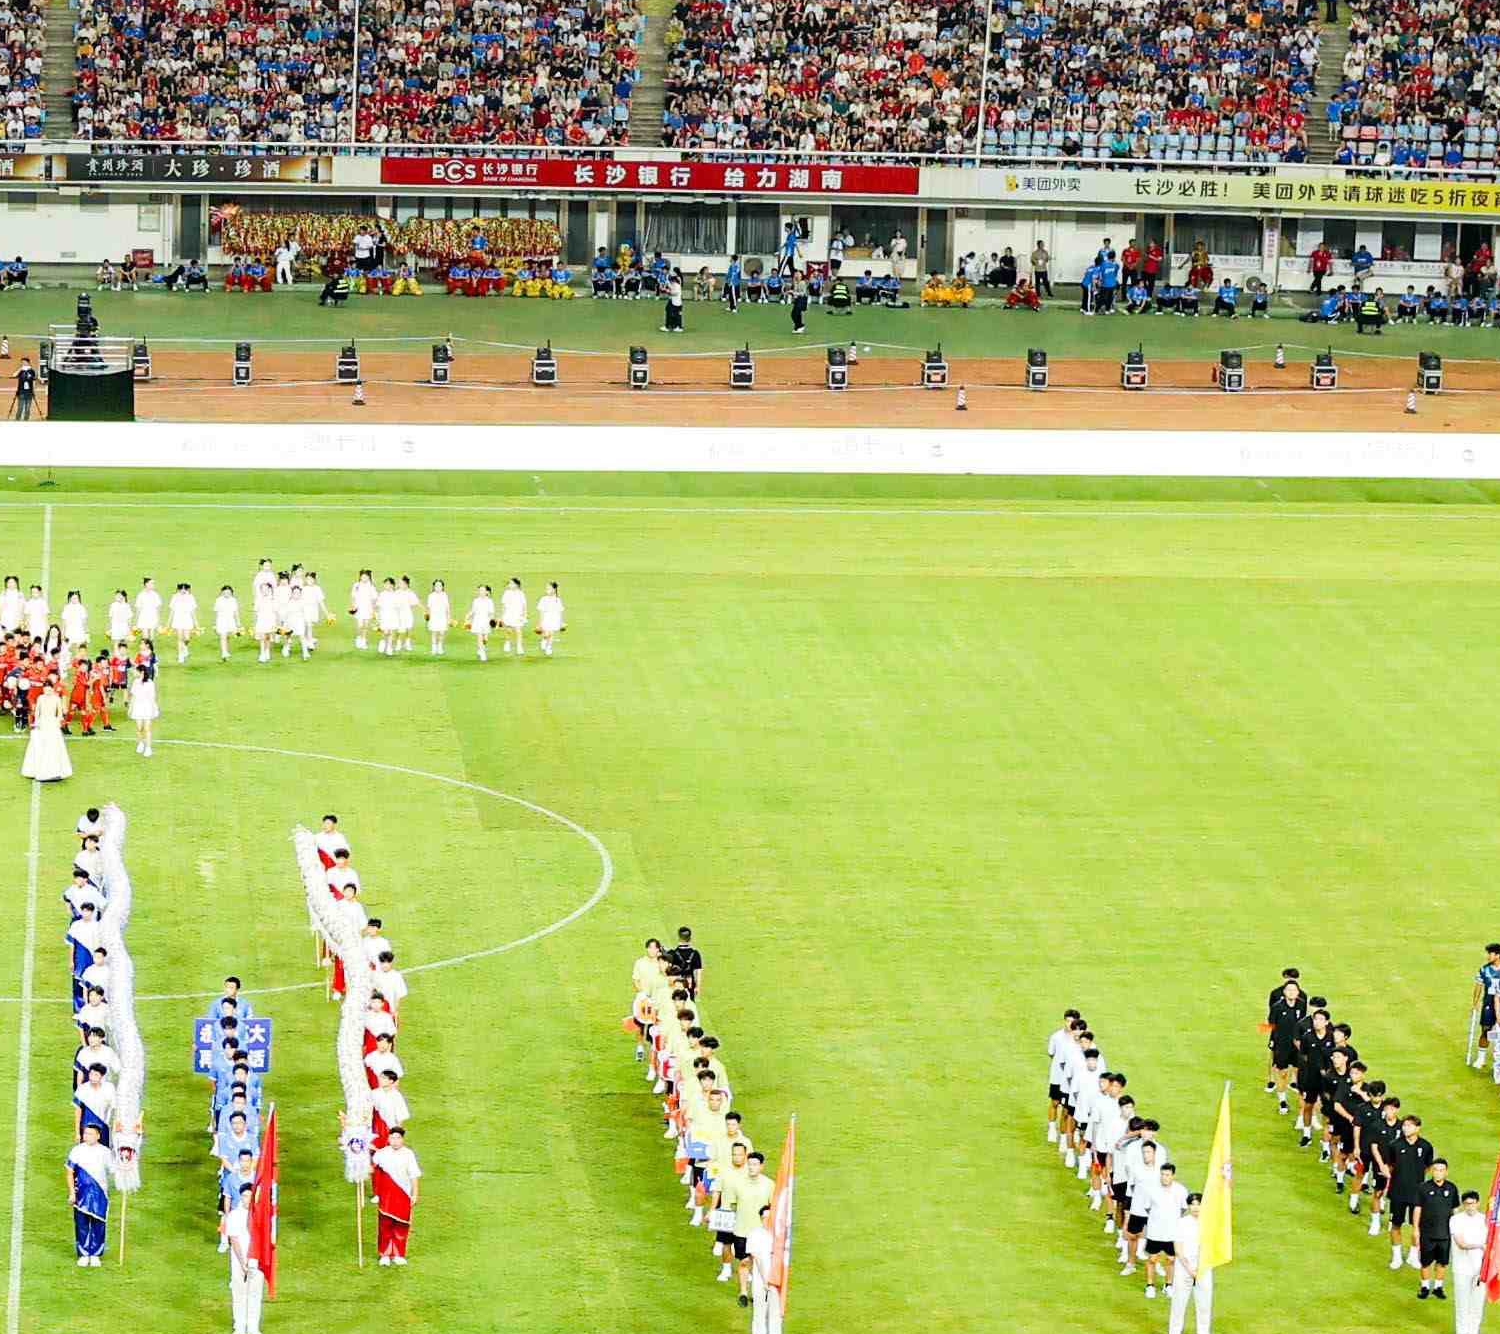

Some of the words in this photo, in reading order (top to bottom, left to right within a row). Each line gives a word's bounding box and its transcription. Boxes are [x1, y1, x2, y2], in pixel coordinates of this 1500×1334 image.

[165, 157, 280, 178] 大珍·珍酒
[433, 160, 476, 183] BCS
[482, 163, 538, 175] 长沙银行
[572, 164, 690, 188] 长沙银行
[724, 168, 842, 189] 给力湖南
[1023, 177, 1080, 191] 美团外卖
